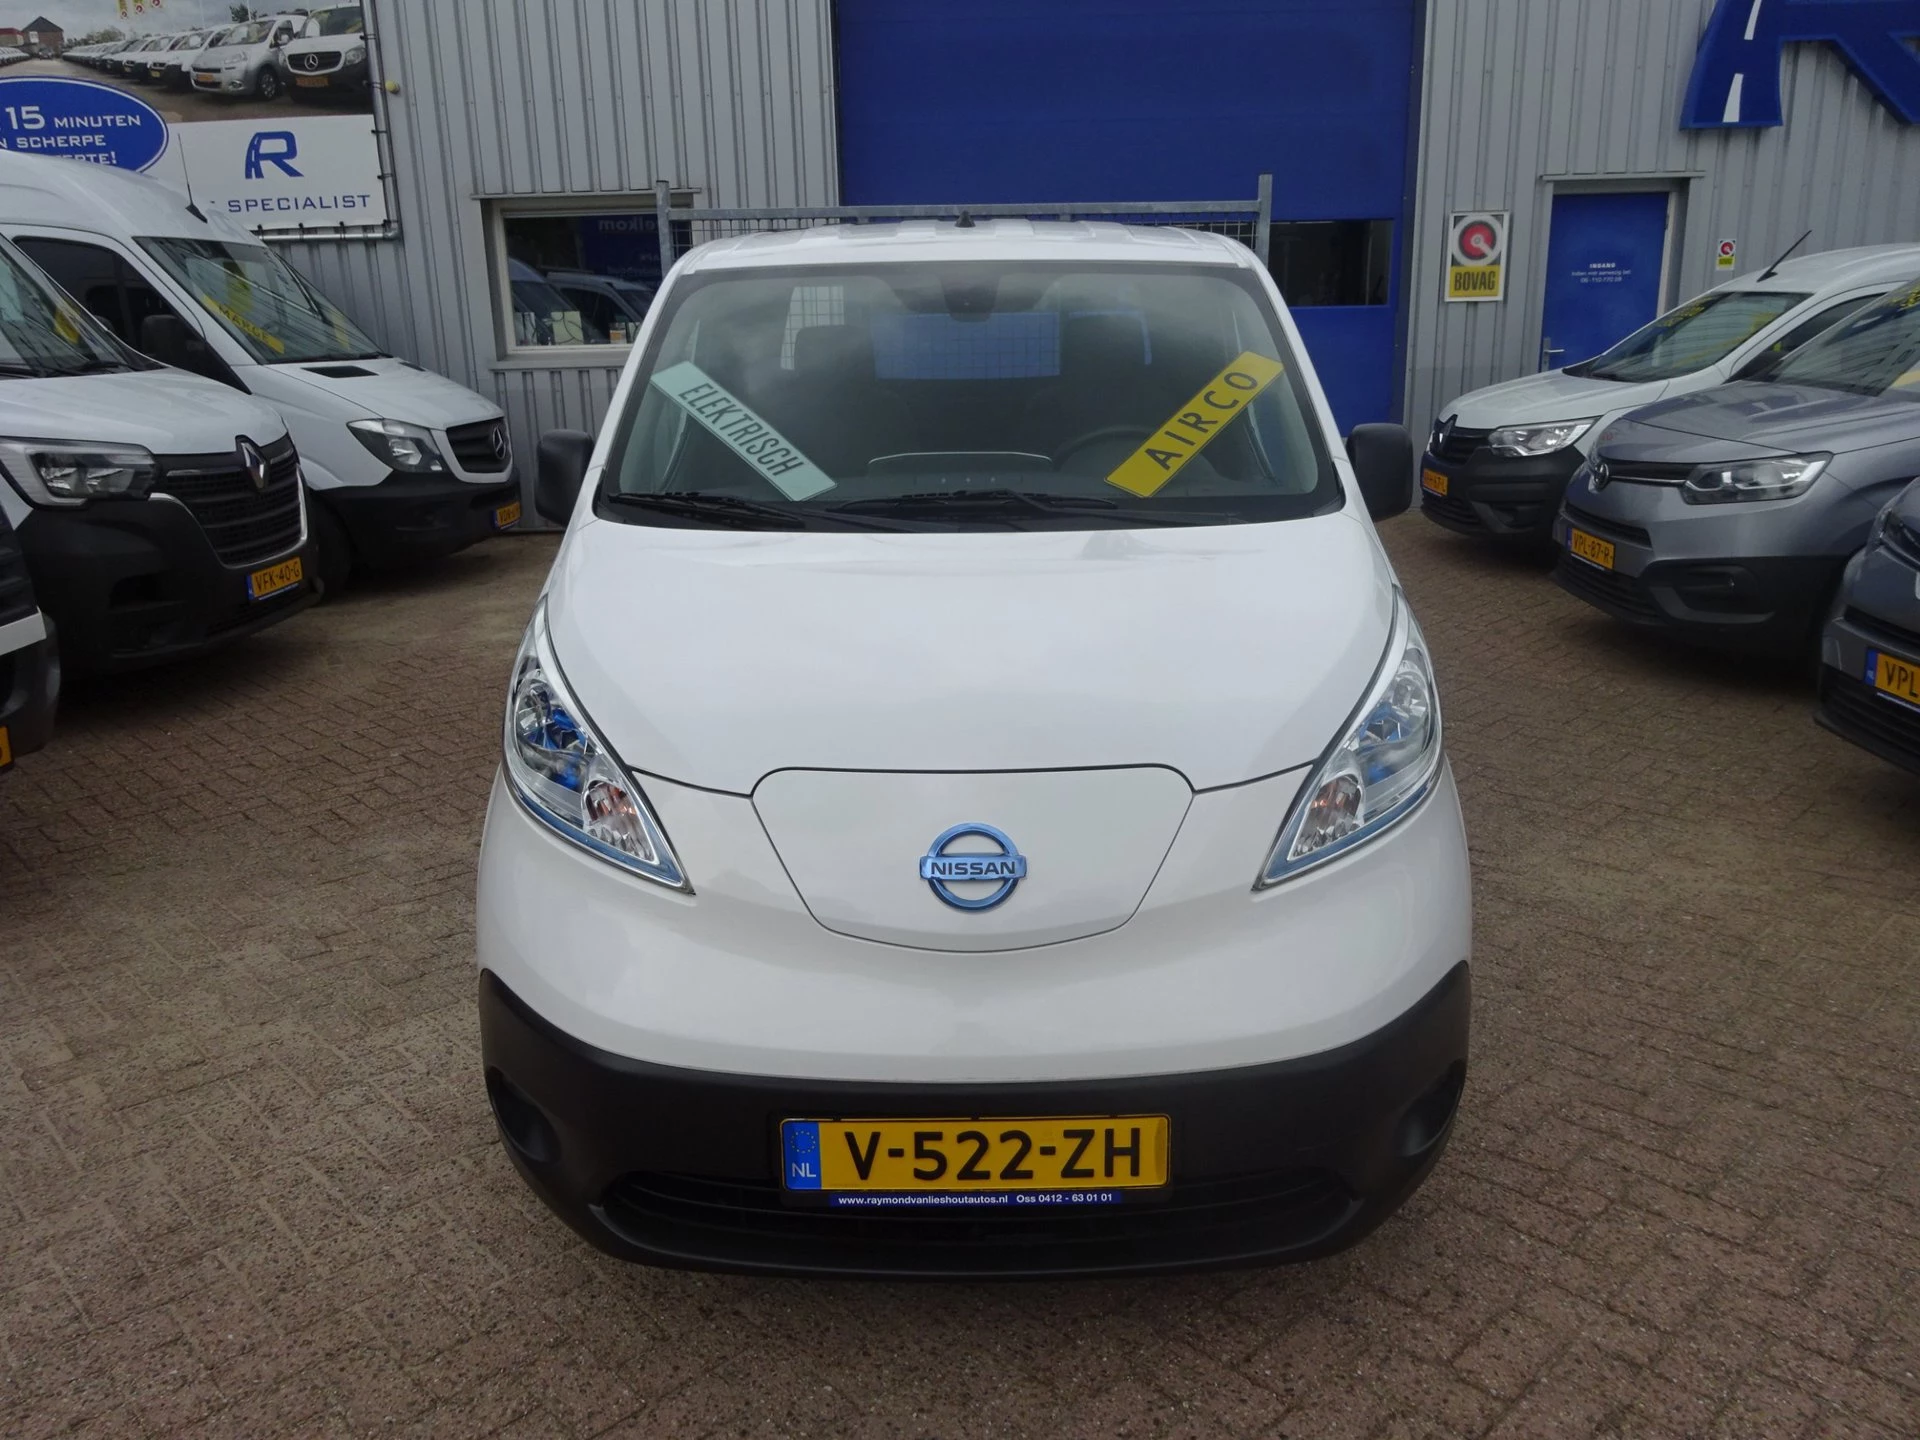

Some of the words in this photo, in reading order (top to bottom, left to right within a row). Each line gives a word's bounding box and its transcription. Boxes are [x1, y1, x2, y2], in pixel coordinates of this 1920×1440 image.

[5, 106, 46, 130] 15
[54, 115, 141, 128] MINUTEN
[17, 134, 106, 149] SCHERPE
[228, 195, 370, 213] SPECIALIST
[1454, 271, 1496, 291] BOVAG
[678, 383, 805, 476] ELEKTRISCH
[1144, 372, 1258, 471] AIRCO
[254, 561, 300, 592] VFK-40-G
[931, 862, 1016, 875] NISSAN
[792, 1162, 817, 1178] NL
[844, 1127, 1140, 1181] V-522-ZH
[838, 1194, 1008, 1206] www.raymondvanlieshoutautos.nl
[1016, 1194, 1036, 1203] Oss
[1038, 1194, 1062, 1203] 0412
[1071, 1194, 1084, 1202] 63
[1086, 1193, 1098, 1202] 01
[1100, 1193, 1112, 1202] 01
